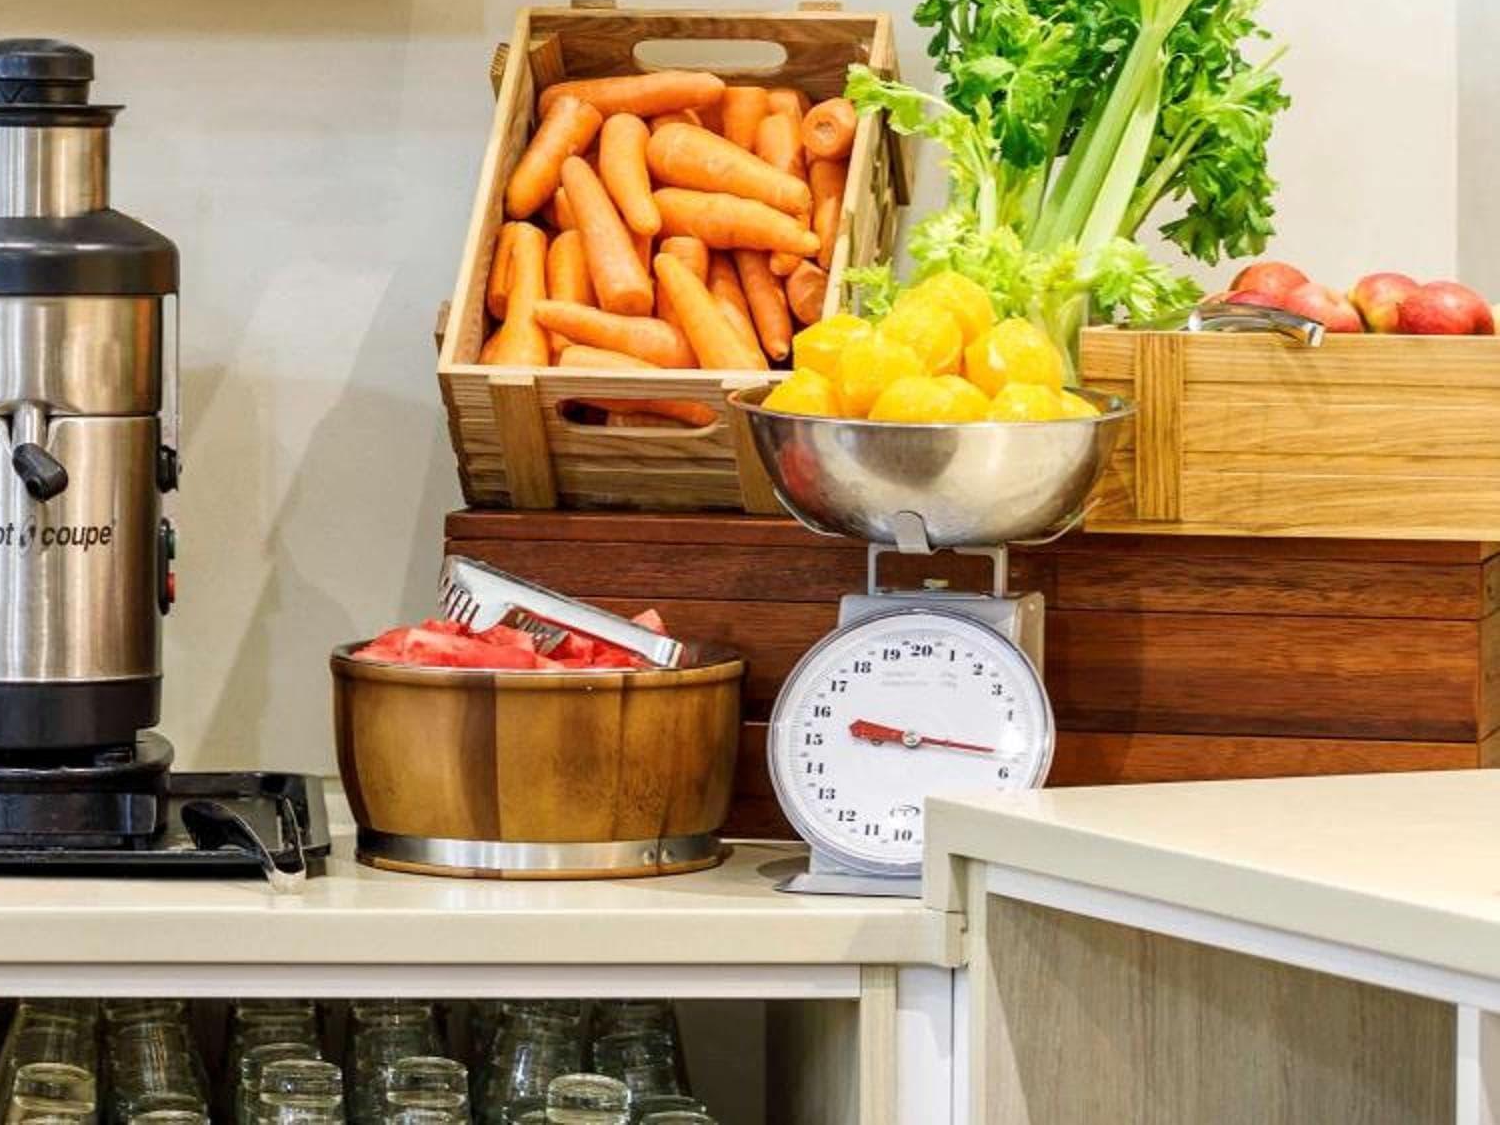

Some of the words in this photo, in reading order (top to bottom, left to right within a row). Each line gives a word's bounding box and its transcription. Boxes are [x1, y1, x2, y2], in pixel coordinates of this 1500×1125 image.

[40, 524, 113, 553] coupe
[882, 648, 901, 661] 19
[910, 644, 933, 657] 20
[853, 660, 872, 674] 18
[973, 662, 984, 676] 2
[831, 680, 849, 693] 17
[990, 684, 1003, 696] 3
[813, 705, 832, 718] 16
[804, 732, 824, 746] 15
[997, 766, 1010, 780] 6
[818, 787, 837, 800] 13
[837, 809, 858, 822] 12
[864, 823, 880, 836] 11
[893, 829, 914, 842] 10
